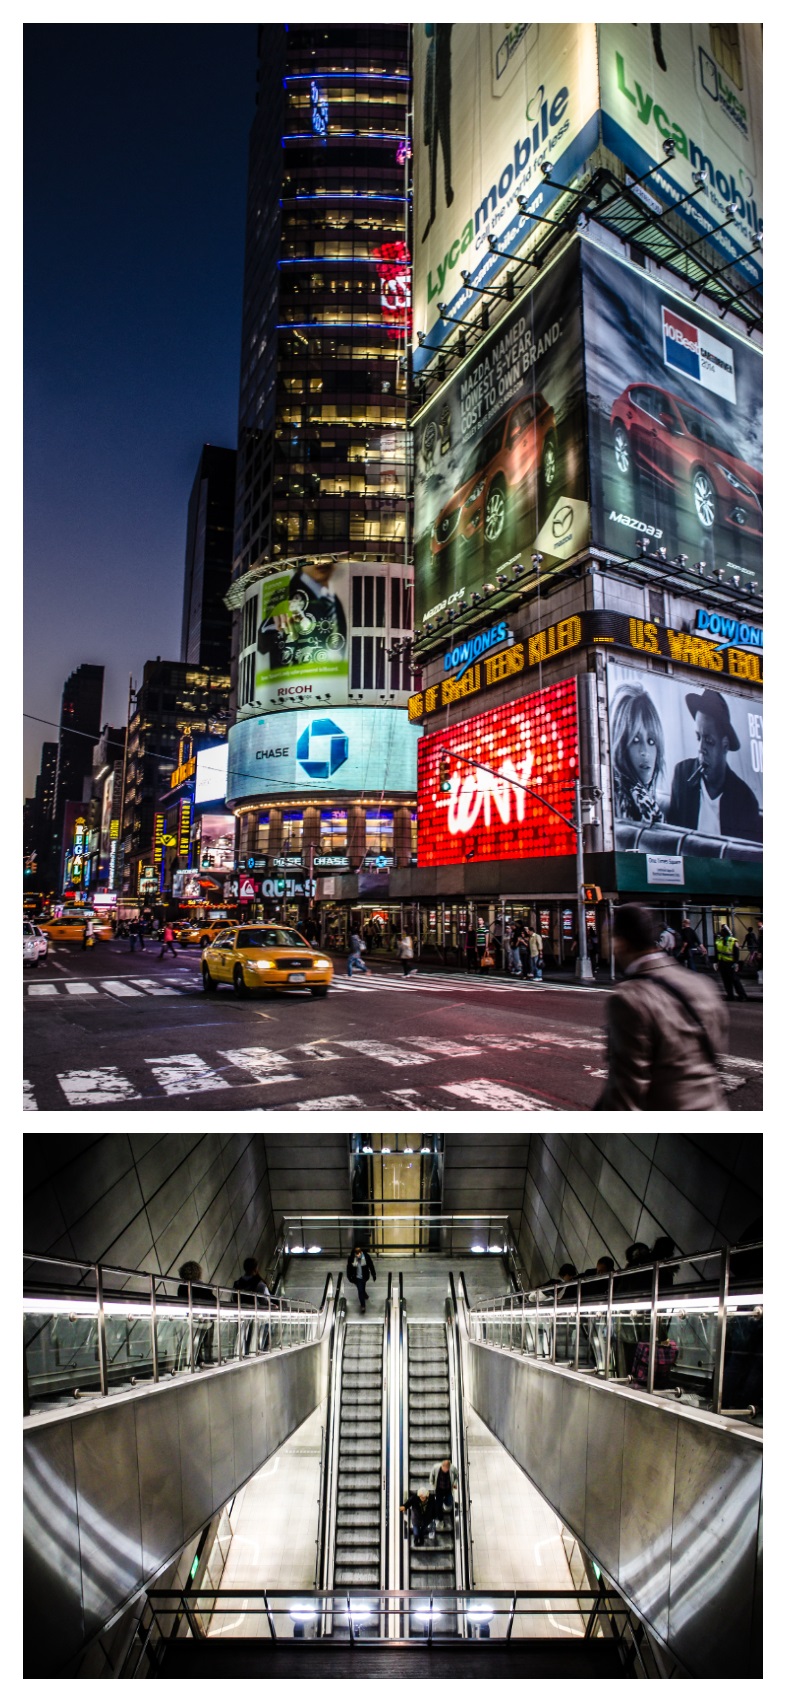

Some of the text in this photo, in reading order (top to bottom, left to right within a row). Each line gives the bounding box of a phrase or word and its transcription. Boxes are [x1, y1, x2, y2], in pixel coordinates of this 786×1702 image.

[615, 50, 763, 232] Lycamobil
[427, 85, 570, 304] Lycamobile
[490, 204, 506, 232] the
[506, 165, 532, 207] world
[533, 147, 548, 171] for
[549, 119, 570, 151] less
[460, 317, 526, 400] MAZDA NAMED
[664, 322, 700, 355] 10Best
[461, 330, 533, 417] LOWEST 5-YEAR
[701, 358, 716, 373] 2014
[461, 402, 485, 433] COST
[485, 387, 496, 409] TO
[498, 363, 520, 396] OWN
[425, 684, 440, 713] OF
[484, 642, 525, 686] TEENS
[528, 615, 582, 667] KILLED
[667, 629, 724, 673] WARNS
[277, 684, 313, 697] RICOH
[255, 746, 289, 760] CHASE
[73, 825, 84, 875] REGAL
[179, 800, 191, 855] NEW VICTORY
[154, 847, 163, 862] NEW
[314, 857, 349, 866] CHASE
